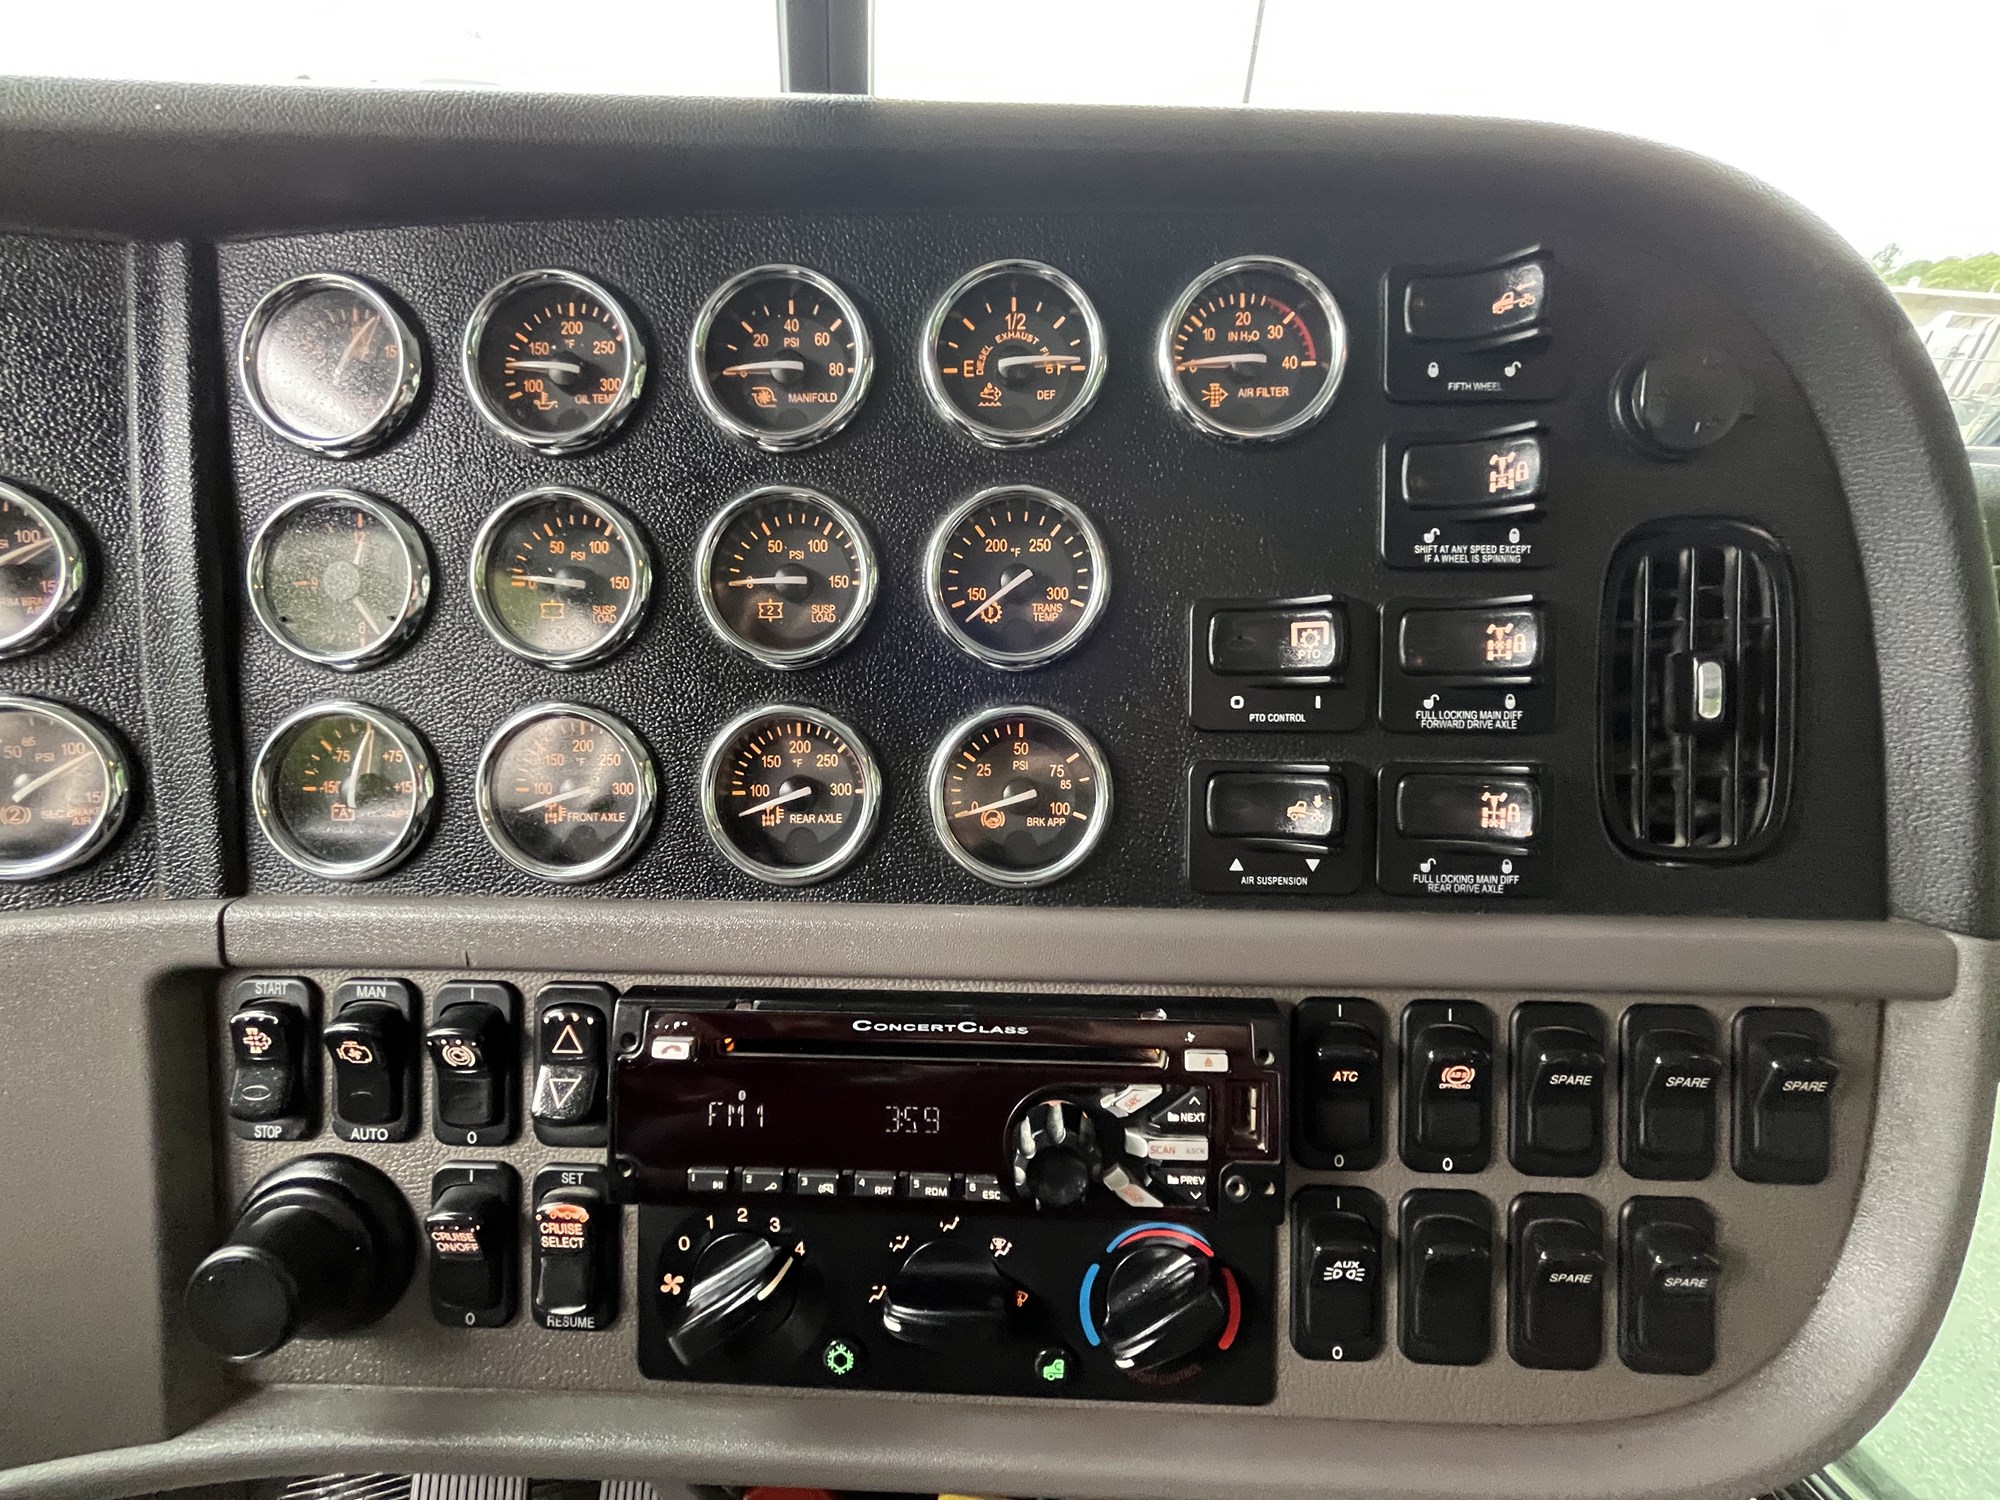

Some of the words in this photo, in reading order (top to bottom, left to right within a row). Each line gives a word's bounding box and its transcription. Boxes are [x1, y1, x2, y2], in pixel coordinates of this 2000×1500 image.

[1004, 313, 1027, 331] 1/2
[1235, 311, 1251, 326] 20
[561, 321, 583, 334] 200
[783, 319, 799, 332] 40
[1267, 325, 1283, 339] 30
[753, 333, 769, 347] 20
[814, 332, 830, 346] 60
[994, 331, 1040, 346] EXHAUST
[1202, 327, 1215, 341] 10
[1227, 331, 1239, 342] IN
[529, 342, 549, 355] 150
[593, 341, 615, 354] 250
[783, 338, 800, 348] PSI
[964, 360, 975, 378] E
[1281, 355, 1298, 370] 40
[828, 363, 845, 376] 80
[524, 380, 544, 392] 100
[600, 379, 622, 391] 300
[1448, 382, 1472, 391] FIFTH
[1473, 382, 1504, 391] WHEEL
[788, 393, 838, 403] MANIFOLD
[1036, 390, 1057, 400] DEF
[1237, 387, 1254, 398] AIR
[1256, 386, 1290, 398] FILTER
[575, 394, 590, 404] OIL
[14, 529, 40, 543] 100
[550, 541, 565, 554] 50
[588, 541, 610, 554] 100
[768, 540, 783, 553] 50
[808, 539, 828, 553] 100
[985, 538, 1007, 552] 200
[1028, 538, 1051, 552] 250
[1414, 545, 1438, 554] SHIFT
[1439, 545, 1450, 554] AT
[1451, 545, 1468, 554] ANY
[1470, 545, 1497, 554] SPEED
[1499, 545, 1531, 554] EXCEPT
[571, 551, 586, 561] PSI
[789, 550, 804, 560] PSI
[1424, 554, 1432, 563] IF
[1433, 555, 1440, 563] A
[1441, 554, 1469, 563] WHEEL
[1471, 555, 1480, 564] IS
[1481, 555, 1521, 564] SPINNING
[609, 576, 630, 589] 150
[829, 575, 849, 588] 150
[967, 587, 987, 601] 150
[1046, 587, 1069, 601] 300
[811, 604, 836, 614] SUSP
[1031, 603, 1063, 613] TRANS
[811, 614, 836, 623] LOAD
[1033, 612, 1059, 622] TEMP
[1249, 713, 1265, 722] PTO
[1267, 713, 1306, 723] CONTROL
[1415, 710, 1437, 720] FULL
[1438, 710, 1477, 720] LOCKING
[1479, 710, 1501, 720] MAIN
[1503, 710, 1523, 720] DIFF
[1421, 720, 1465, 729] FORWARD
[1467, 720, 1493, 729] DRIVE
[1495, 720, 1517, 729] AXLE
[3, 745, 22, 758] 50
[61, 742, 85, 755] 100
[572, 739, 594, 752] 200
[789, 740, 811, 753] 200
[1013, 742, 1029, 755] 50
[600, 753, 621, 766] 250
[761, 754, 781, 768] 150
[816, 753, 839, 767] 250
[1012, 761, 1028, 770] PSI
[976, 764, 992, 776] 25
[1050, 764, 1065, 777] 75
[534, 782, 553, 795] 100
[612, 781, 634, 795] 300
[749, 784, 770, 797] 100
[830, 782, 852, 796] 300
[1060, 780, 1072, 790] 85
[1050, 802, 1071, 815] 100
[567, 812, 598, 822] FRONT
[600, 811, 626, 822] AXLE
[789, 814, 816, 824] REAR
[817, 813, 842, 824] AXLE
[1026, 816, 1046, 826] BRK
[1047, 816, 1067, 826] APP
[1241, 876, 1255, 885] AIR
[1256, 876, 1308, 886] SUSPENSION
[1412, 873, 1434, 884] FULL
[1435, 874, 1474, 884] LOCKING
[1476, 874, 1499, 884] MAIN
[1500, 875, 1520, 885] DIFF
[1427, 883, 1452, 893] REAR
[1454, 883, 1480, 894] DRIVE
[1481, 884, 1504, 894] AXLE
[254, 981, 289, 995] START
[356, 986, 387, 998] MAN
[1332, 1070, 1359, 1083] ATC
[1549, 1074, 1593, 1087] SPARE
[1665, 1076, 1711, 1090] SPARE
[1782, 1080, 1829, 1093] SPARE
[885, 1106, 940, 1134] 3:59
[1180, 1112, 1206, 1122] NEXT
[254, 1125, 282, 1139] STOP
[349, 1127, 389, 1141] AUTO
[1150, 1145, 1176, 1155] SCAN
[561, 1172, 585, 1185] SET
[801, 1177, 809, 1187] 3
[1180, 1175, 1206, 1186] PREV
[859, 1178, 866, 1188] 4
[874, 1186, 893, 1196] RPT
[982, 1190, 1001, 1201] ESC
[737, 1207, 748, 1222] 2
[705, 1214, 714, 1230] 1
[769, 1216, 781, 1233] 3
[540, 1222, 584, 1236] CRUISE
[431, 1231, 478, 1243] CRUISE
[541, 1235, 585, 1249] SELECT
[436, 1241, 480, 1252] ON/OFF
[794, 1240, 805, 1257] 4
[1333, 1260, 1360, 1269] AUX
[1549, 1273, 1593, 1284] SPARE
[1664, 1277, 1709, 1289] SPARE
[546, 1314, 595, 1329] RESUME
